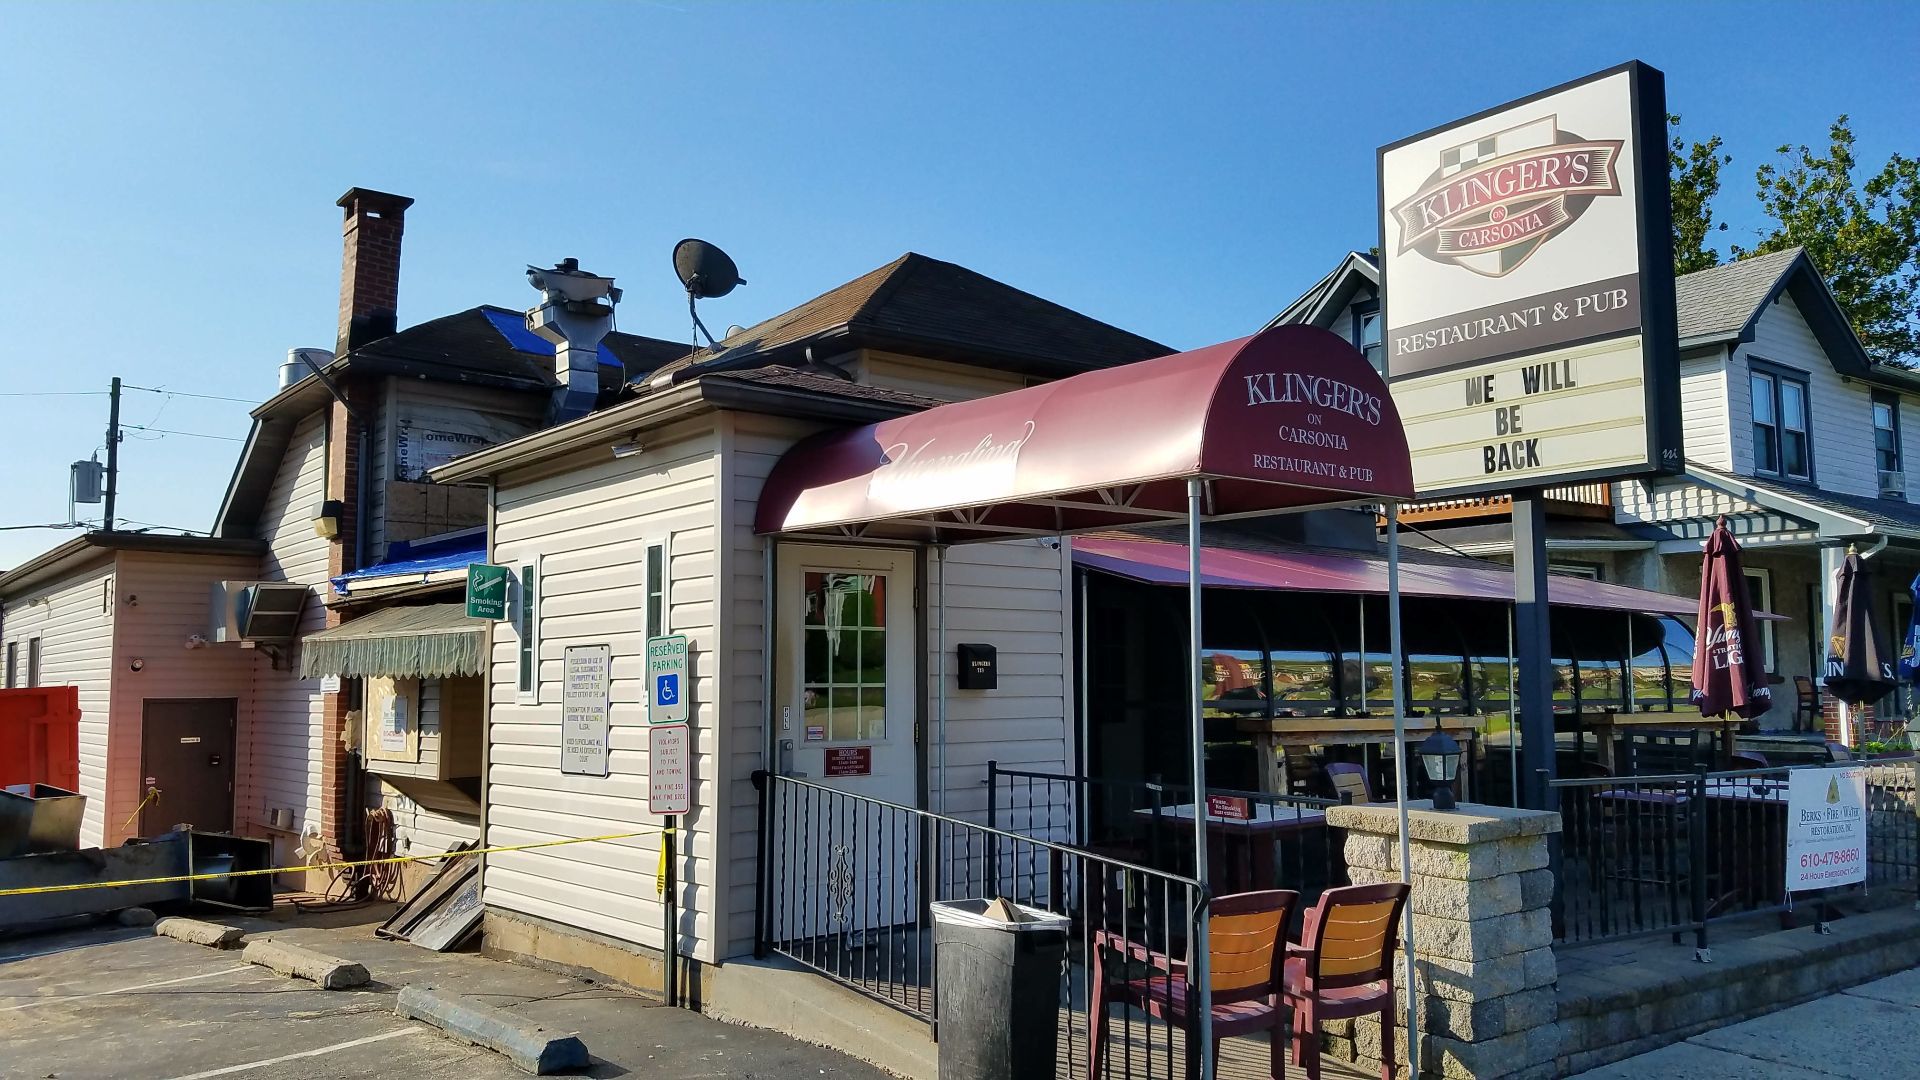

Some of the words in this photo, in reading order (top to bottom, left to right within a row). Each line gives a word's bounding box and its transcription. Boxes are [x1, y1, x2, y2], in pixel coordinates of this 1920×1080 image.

[1417, 153, 1590, 229] KLINGER'S
[1492, 208, 1505, 219] ON
[1458, 213, 1544, 248] CARSONIA
[1396, 305, 1546, 356] RESTAURANT
[1551, 302, 1569, 322] &
[1575, 288, 1628, 317] PUB
[1465, 374, 1495, 406] WE
[1521, 359, 1576, 395] WILL
[1244, 373, 1381, 426] KLINGER'S
[1307, 413, 1322, 425] ON
[1495, 404, 1522, 436] BE
[1279, 425, 1348, 451] CARSONIA
[1483, 437, 1541, 474] BACK
[1253, 453, 1337, 477] RESTAURANT
[1338, 465, 1348, 479] &
[1350, 466, 1373, 482] PUB
[470, 596, 503, 608] Smoking
[477, 605, 495, 614] Area
[650, 643, 685, 657] RESERVED
[652, 658, 683, 672] PARKING
[656, 768, 666, 776] AND
[666, 767, 682, 775] TOWING
[1221, 804, 1241, 812] Smoking
[1800, 873, 1809, 881] 24
[1809, 872, 1824, 880] HOUR
